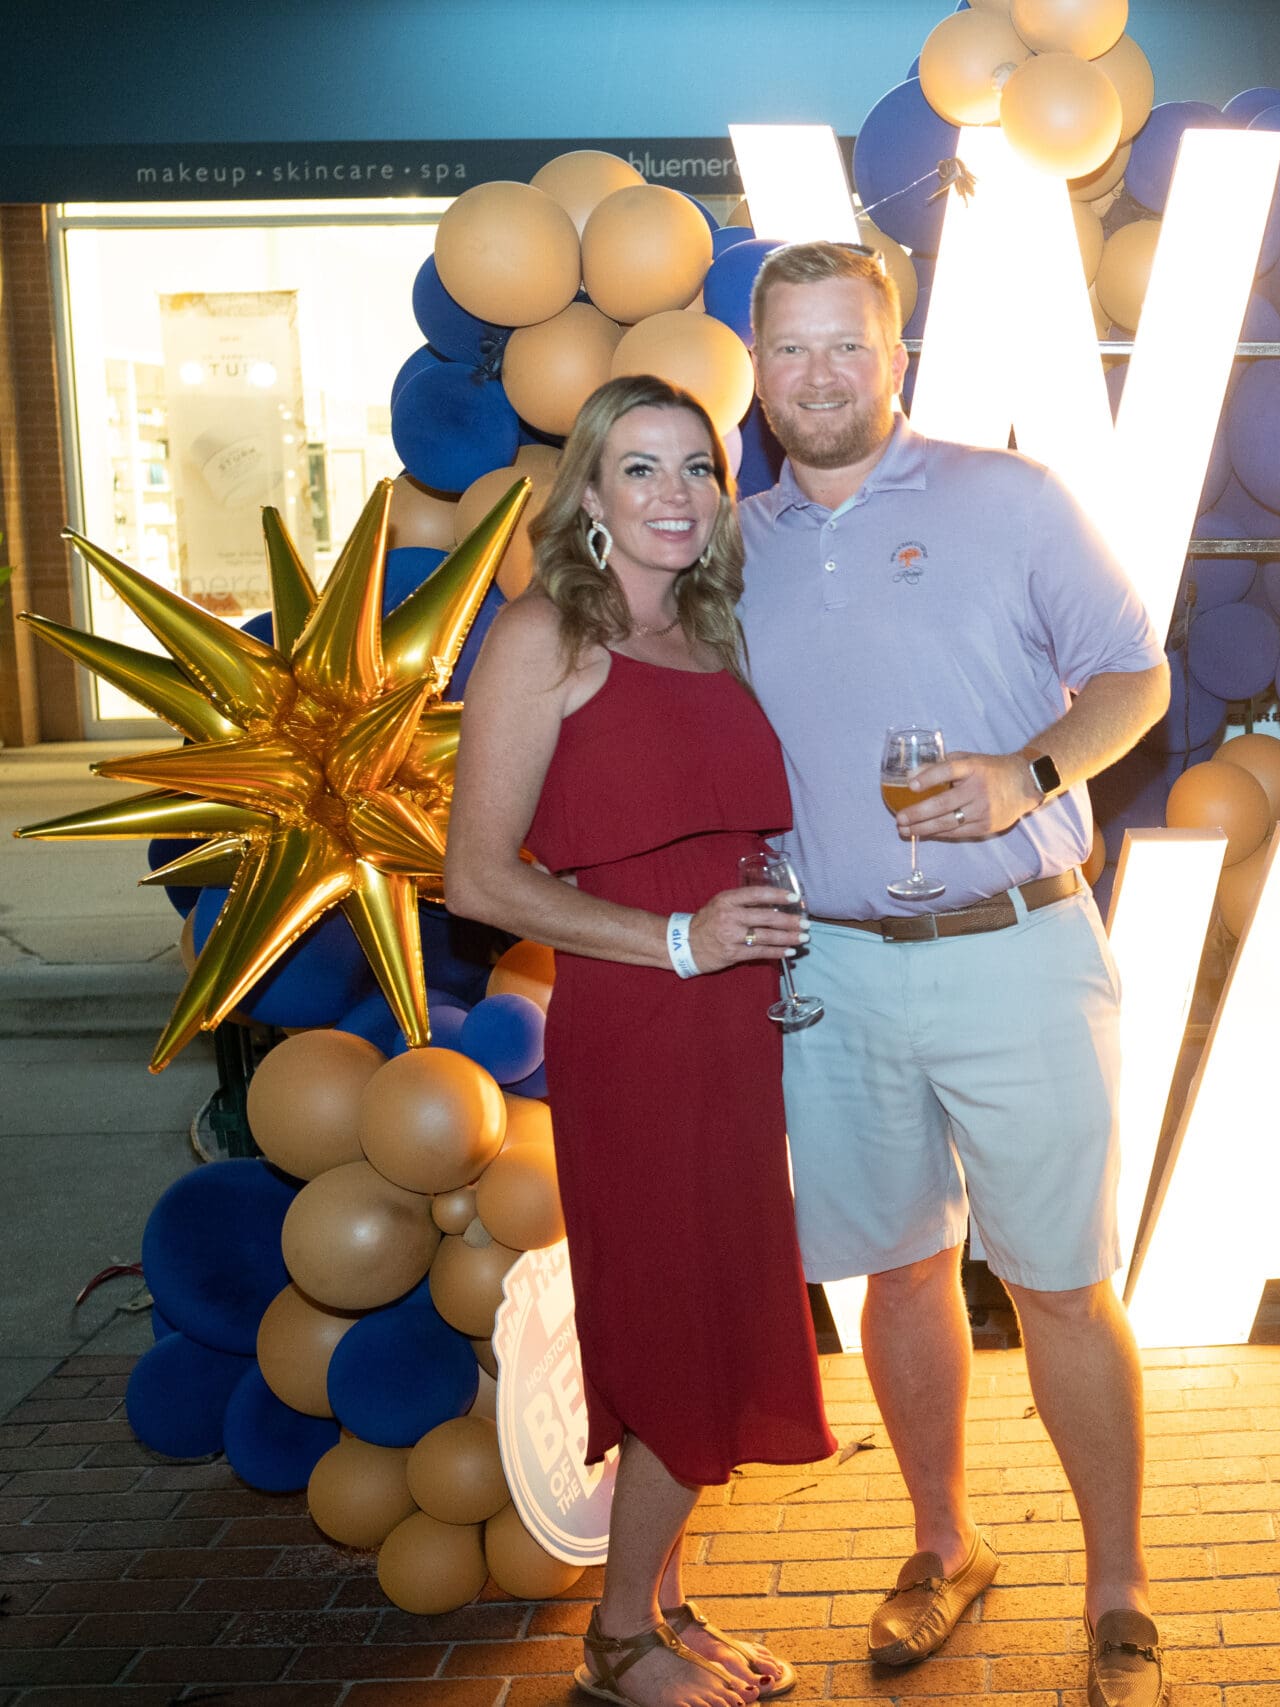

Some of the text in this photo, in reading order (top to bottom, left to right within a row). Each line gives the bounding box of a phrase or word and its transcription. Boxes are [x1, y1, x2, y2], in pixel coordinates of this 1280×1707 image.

[137, 160, 467, 187] makeup skincare spa
[672, 928, 682, 951] VIP
[524, 1326, 574, 1392] HOUSTON
[522, 1341, 588, 1475] BE
[550, 1455, 574, 1498] OF
[556, 1480, 583, 1516] THE
